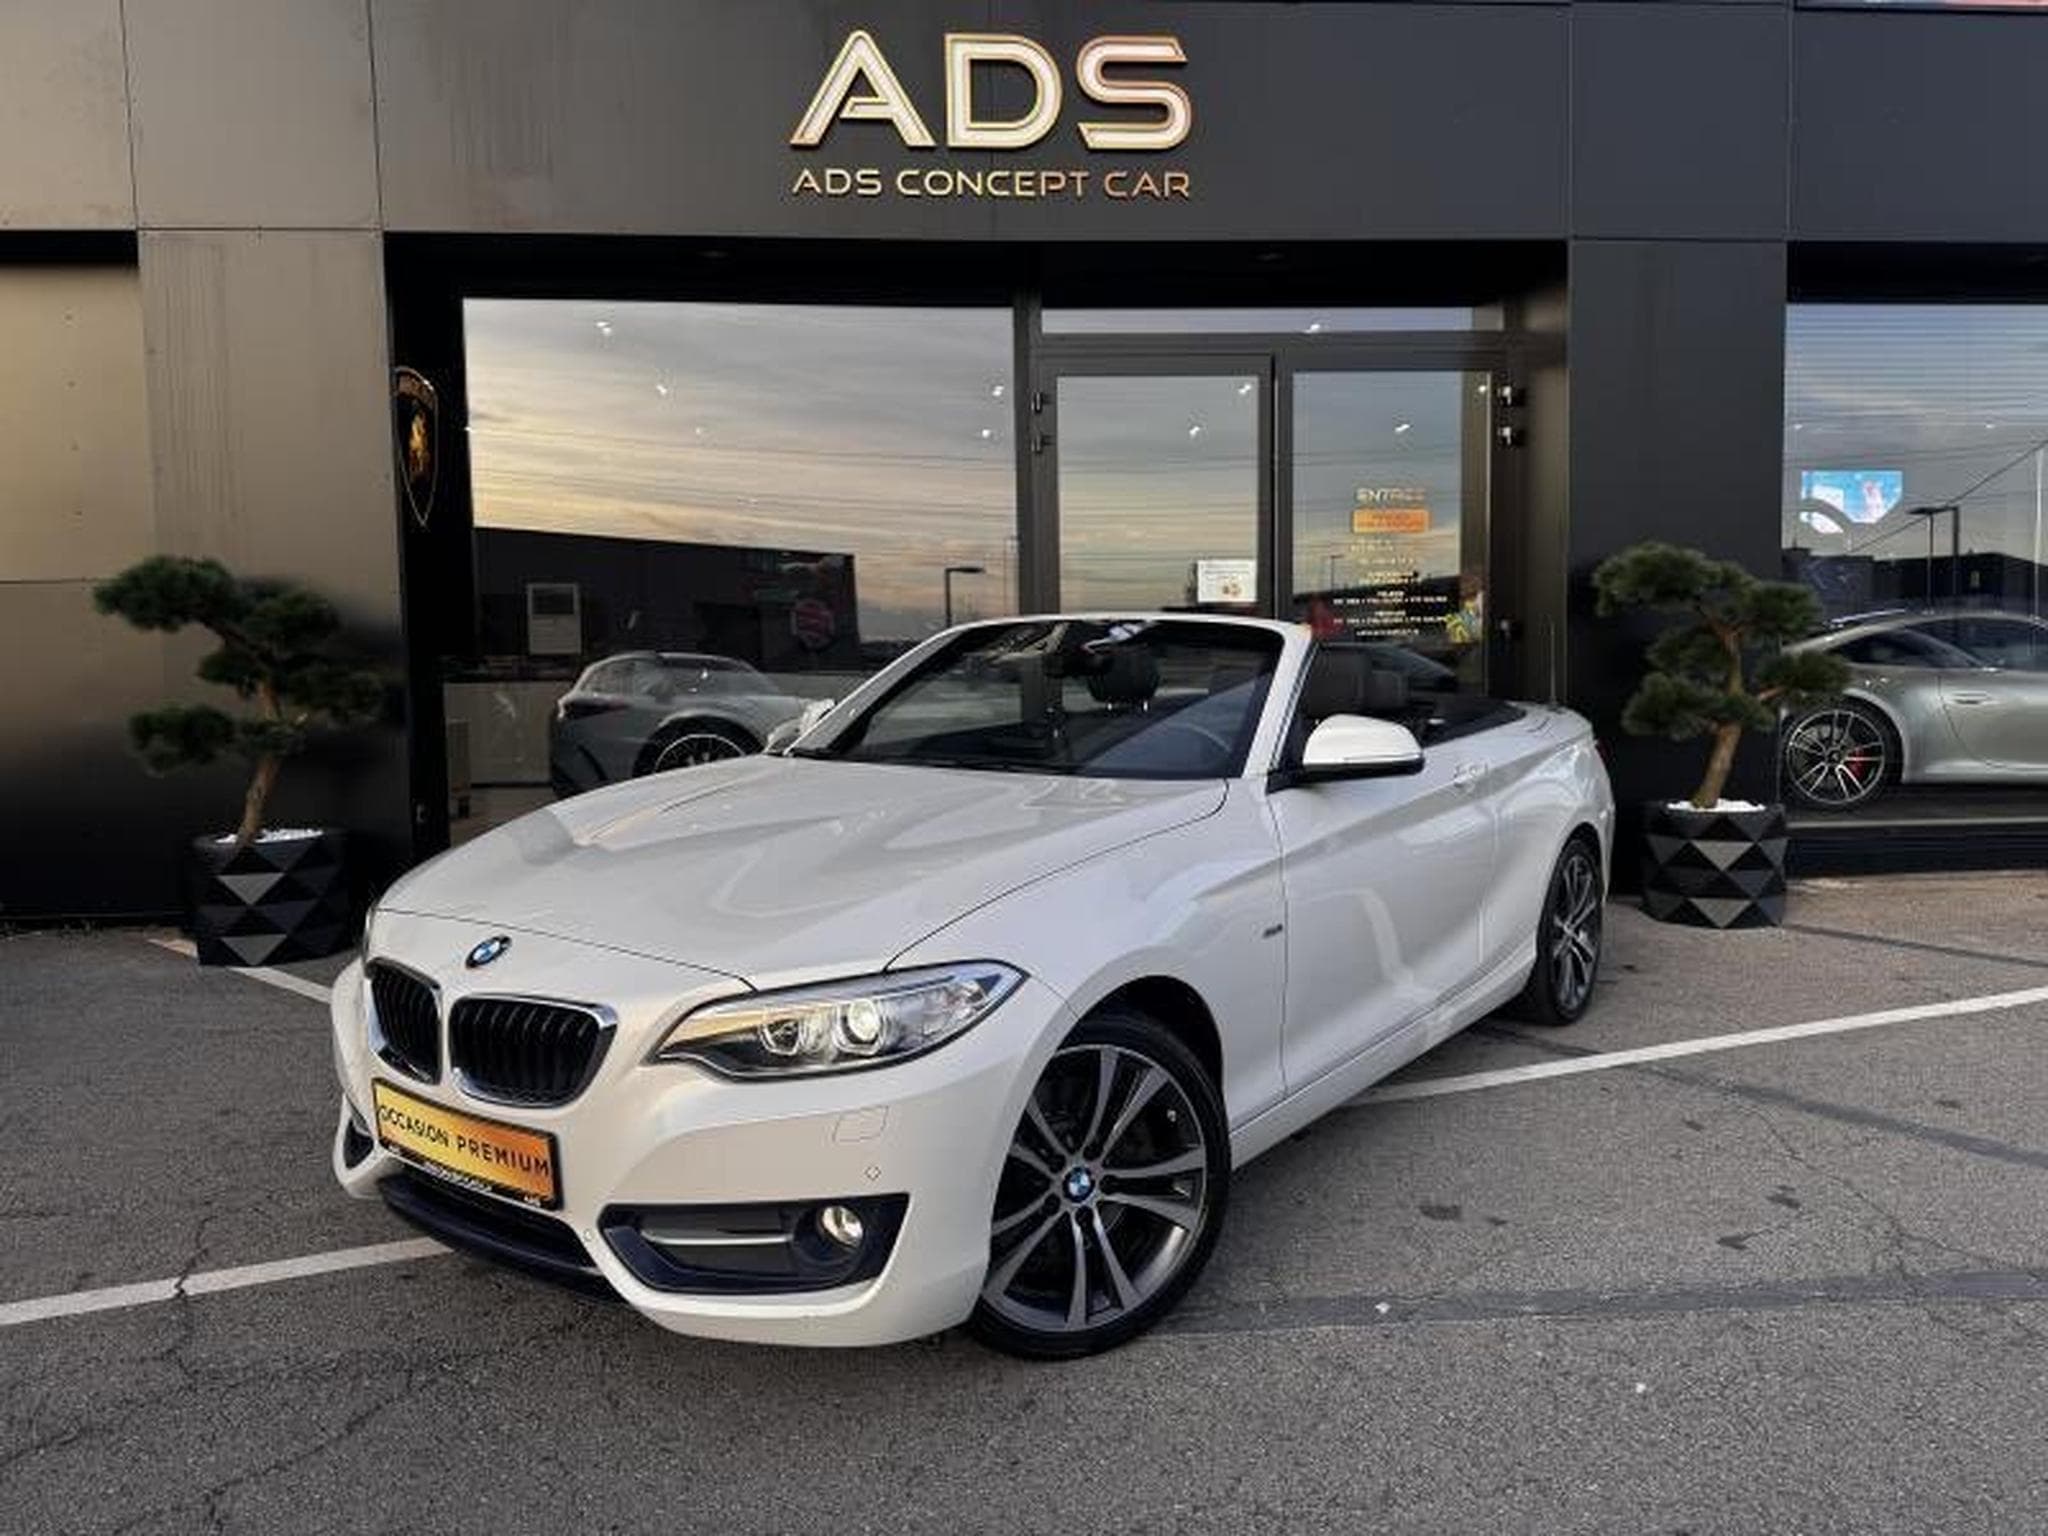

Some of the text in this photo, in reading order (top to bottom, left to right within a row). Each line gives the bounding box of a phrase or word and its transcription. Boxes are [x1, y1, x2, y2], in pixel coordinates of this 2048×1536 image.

[789, 29, 1192, 150] ADS
[791, 168, 1190, 198] ADS CONCEPT CAR
[377, 1104, 549, 1176] OCCASION PREMIUM
